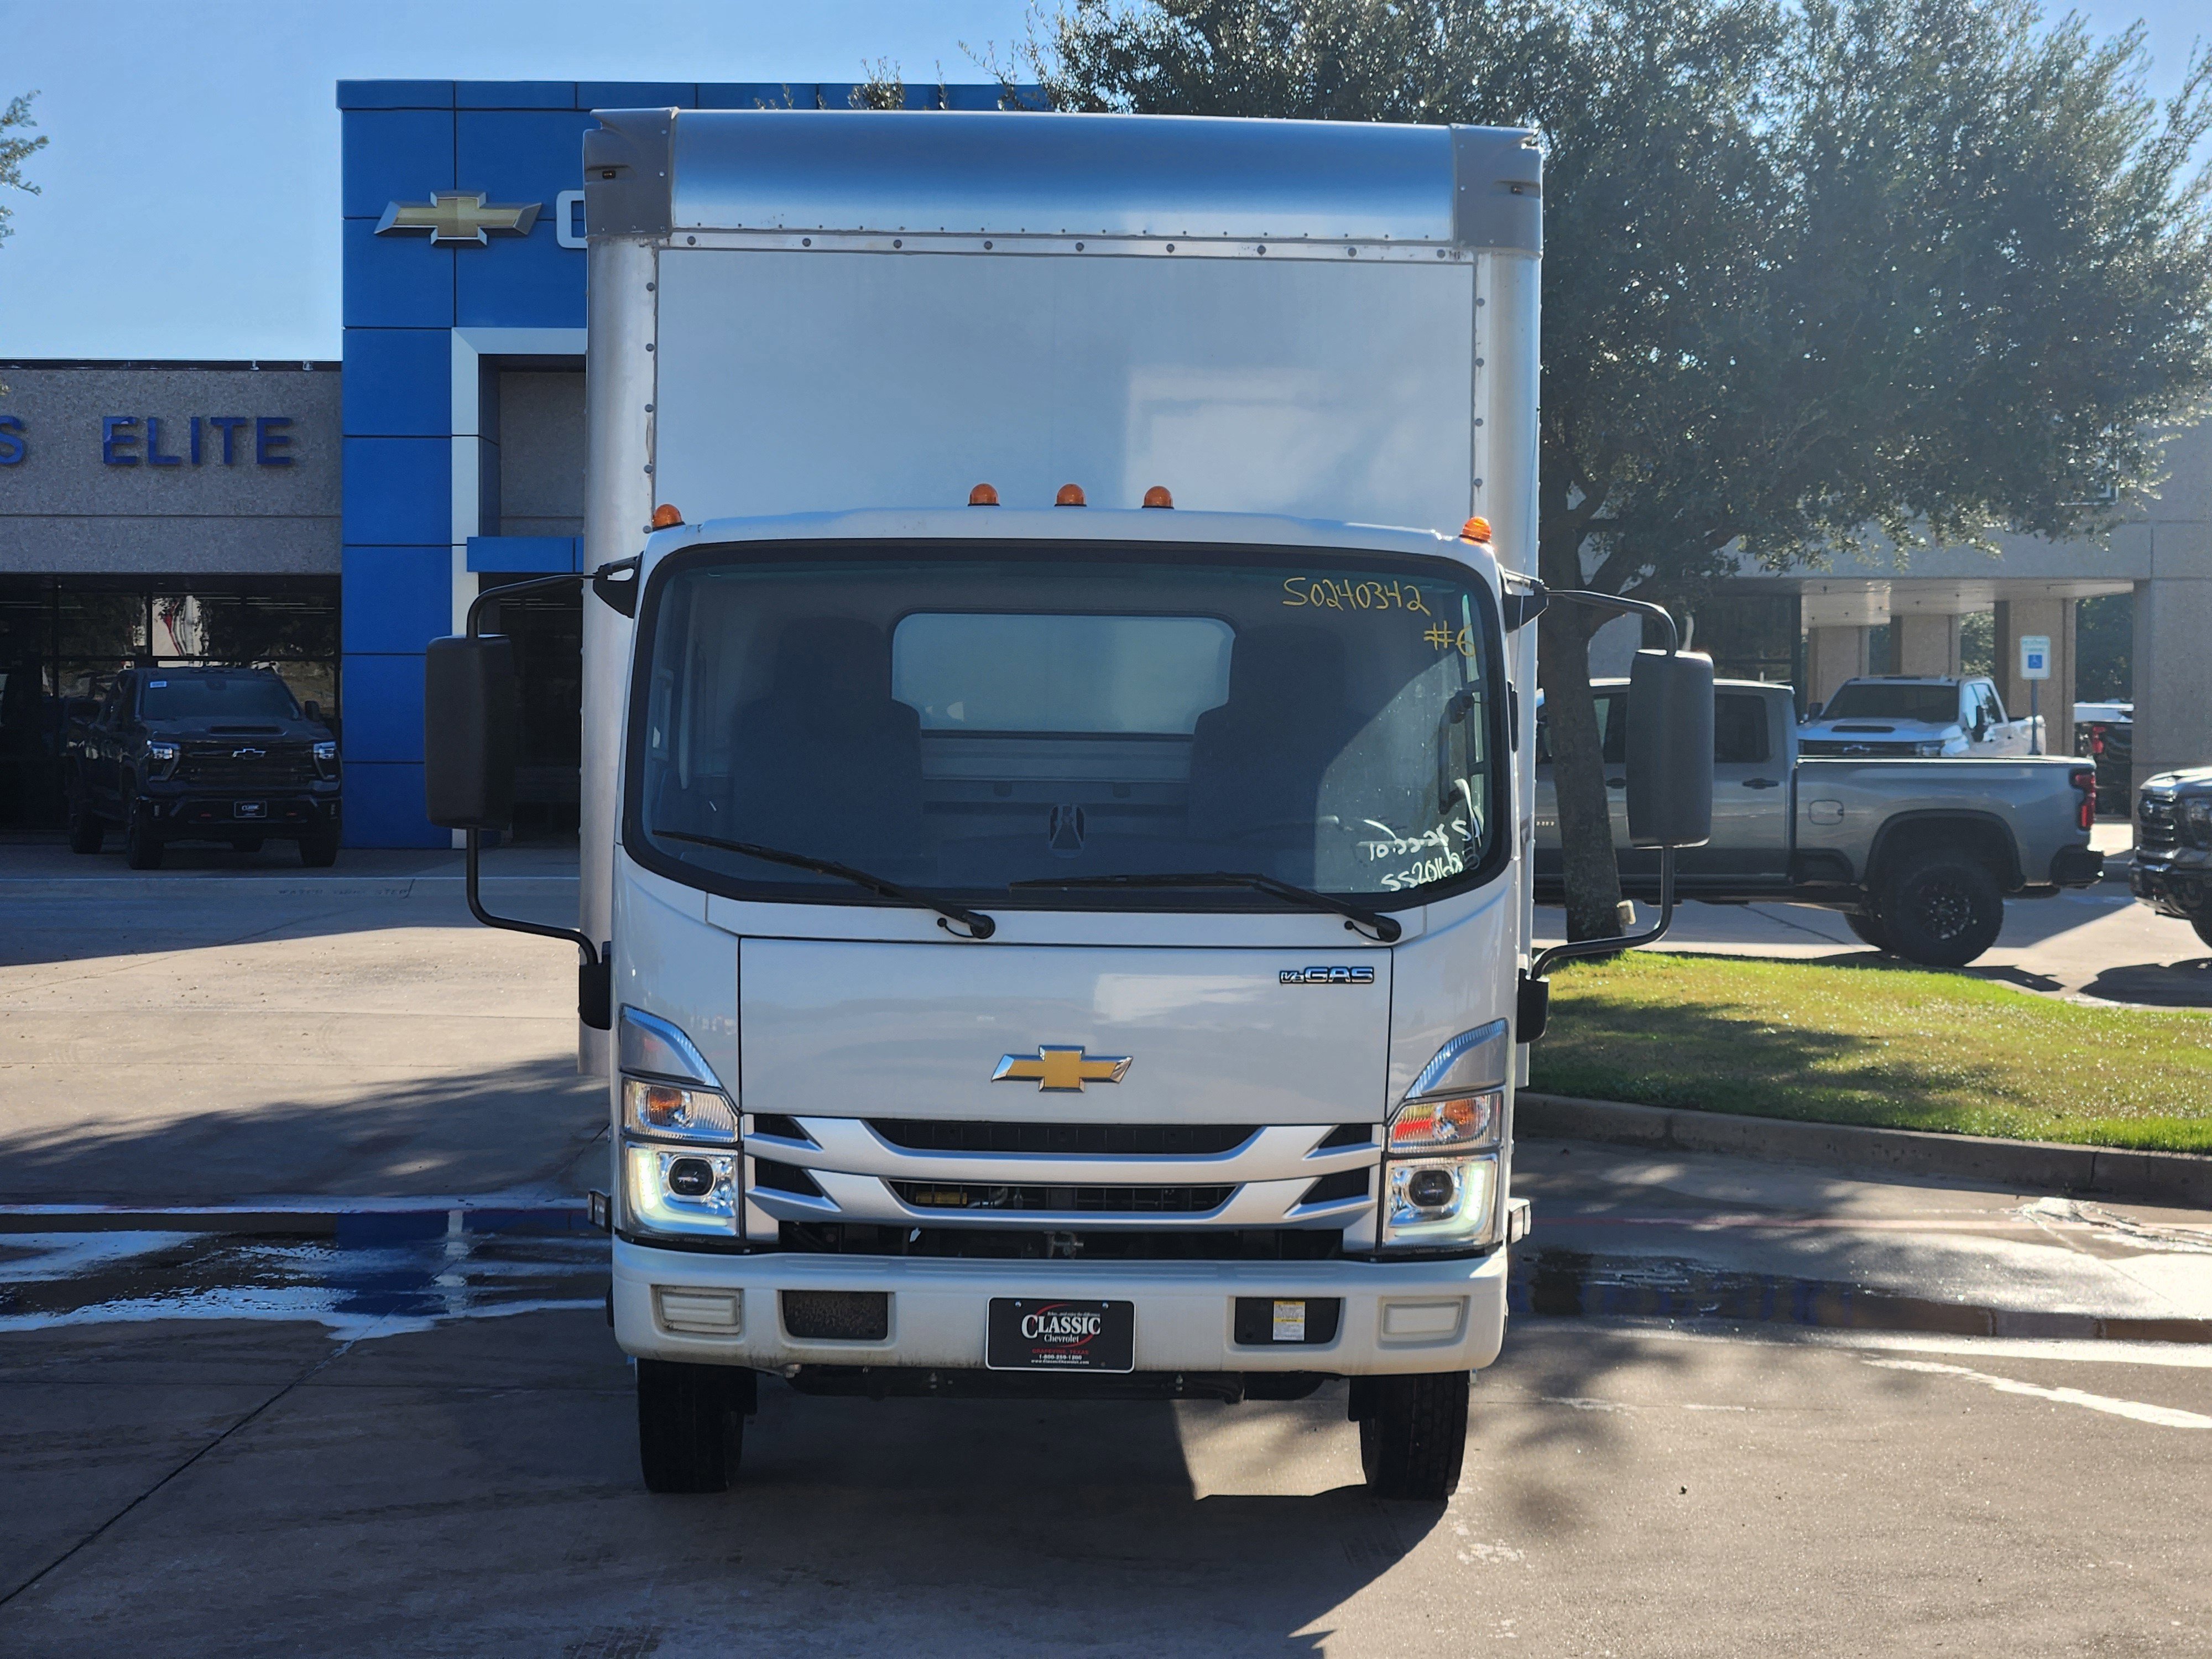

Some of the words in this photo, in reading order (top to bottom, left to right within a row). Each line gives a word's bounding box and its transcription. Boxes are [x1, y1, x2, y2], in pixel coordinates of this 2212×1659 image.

[102, 416, 293, 466] ELITE
[1423, 620, 1476, 657] #6
[1305, 966, 1374, 984] GAS
[1021, 1314, 1100, 1339] CLASSIC
[1044, 1334, 1079, 1343] Chevrolet
